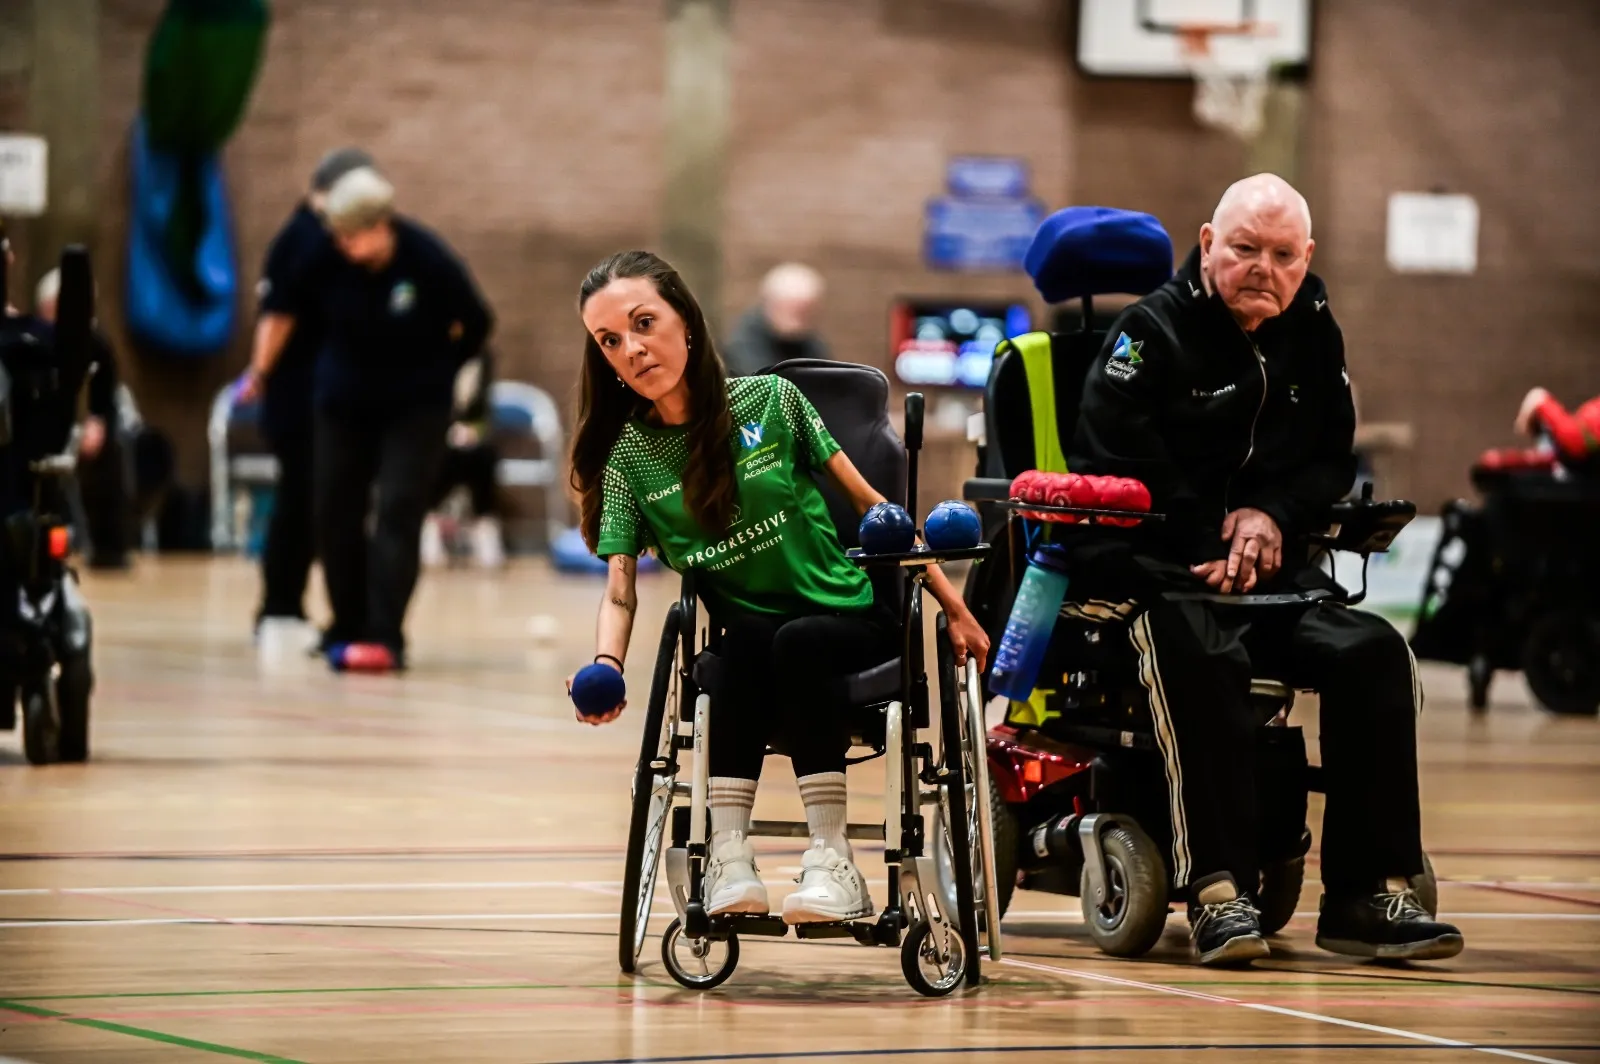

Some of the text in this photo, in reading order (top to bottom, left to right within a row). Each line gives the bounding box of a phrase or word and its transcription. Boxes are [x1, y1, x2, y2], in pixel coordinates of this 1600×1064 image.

[743, 459, 782, 481] Academy
[746, 452, 775, 470] Boccia
[686, 510, 787, 567] PROGRESSIVE
[751, 534, 783, 554] SOCIETY
